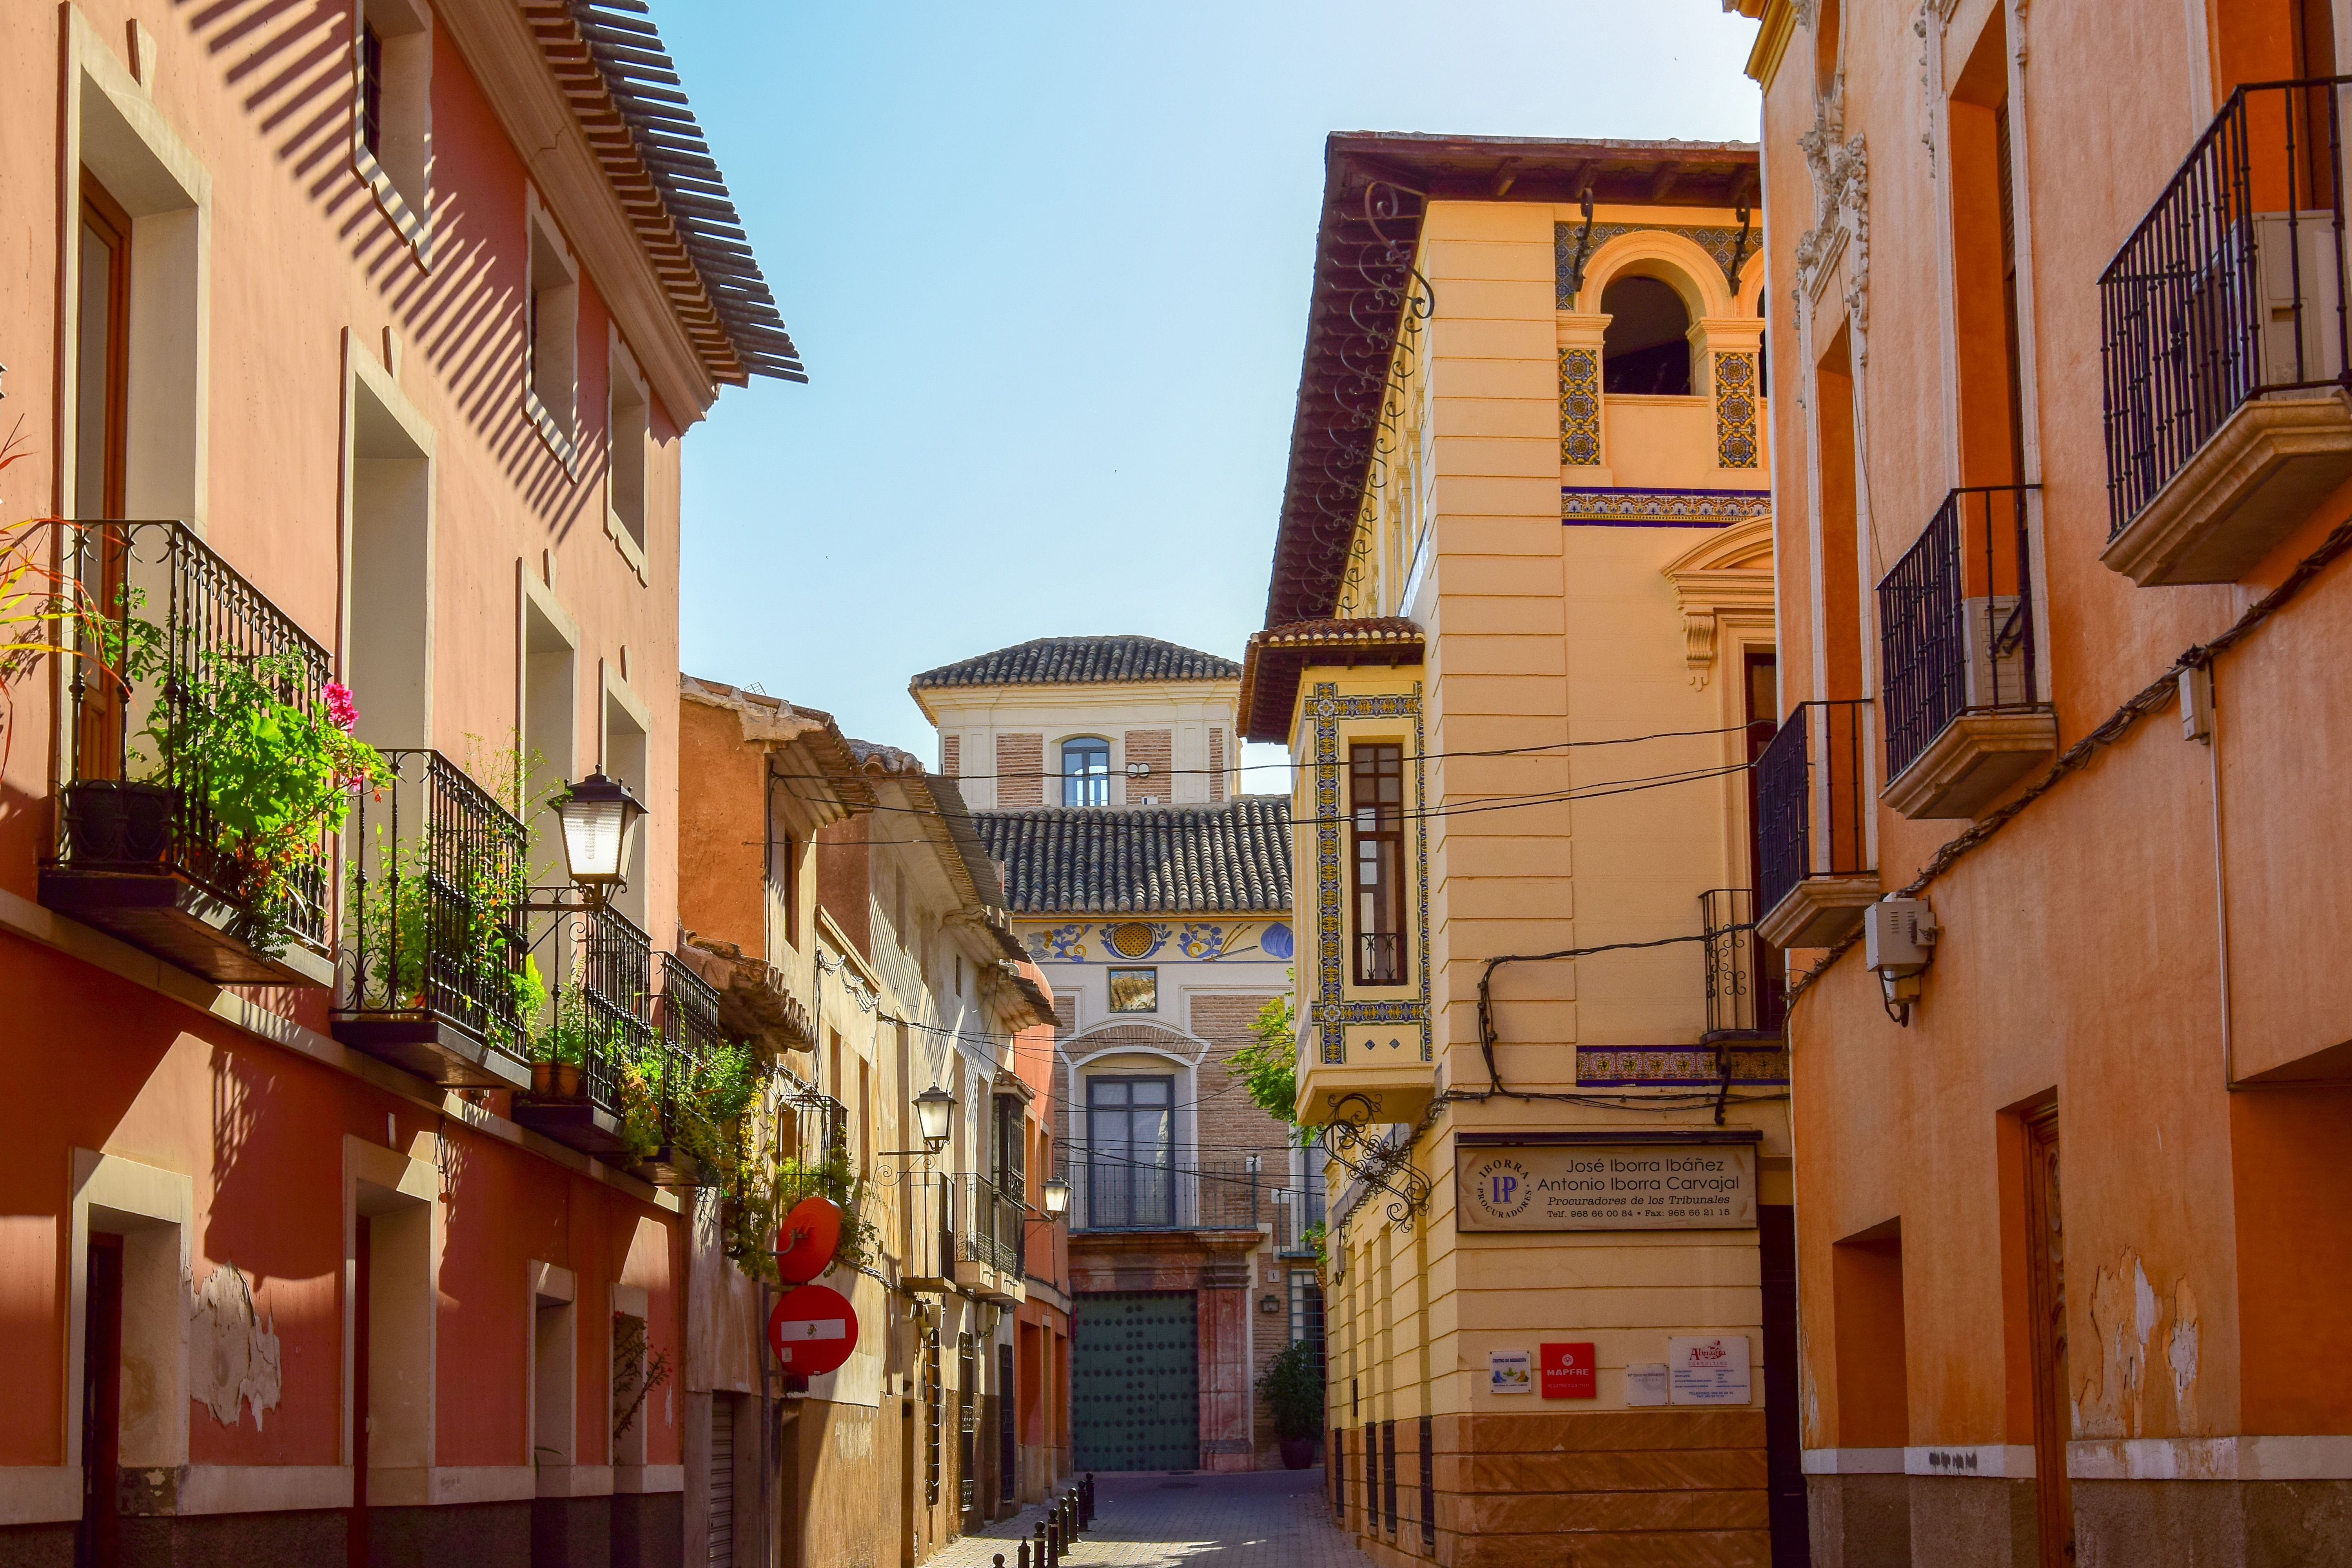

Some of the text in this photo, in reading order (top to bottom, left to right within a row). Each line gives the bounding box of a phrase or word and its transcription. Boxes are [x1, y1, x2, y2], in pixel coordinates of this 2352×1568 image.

[1479, 1159, 1529, 1180] IBORRA
[1566, 1158, 1724, 1172] José Iborra Ibáñez
[1492, 1176, 1518, 1204] IP
[1537, 1176, 1739, 1192] Antonio Iborra Carvajal
[1477, 1188, 1532, 1218] PROCURADORES
[1547, 1196, 1730, 1205] Procuradores de los Tribunales
